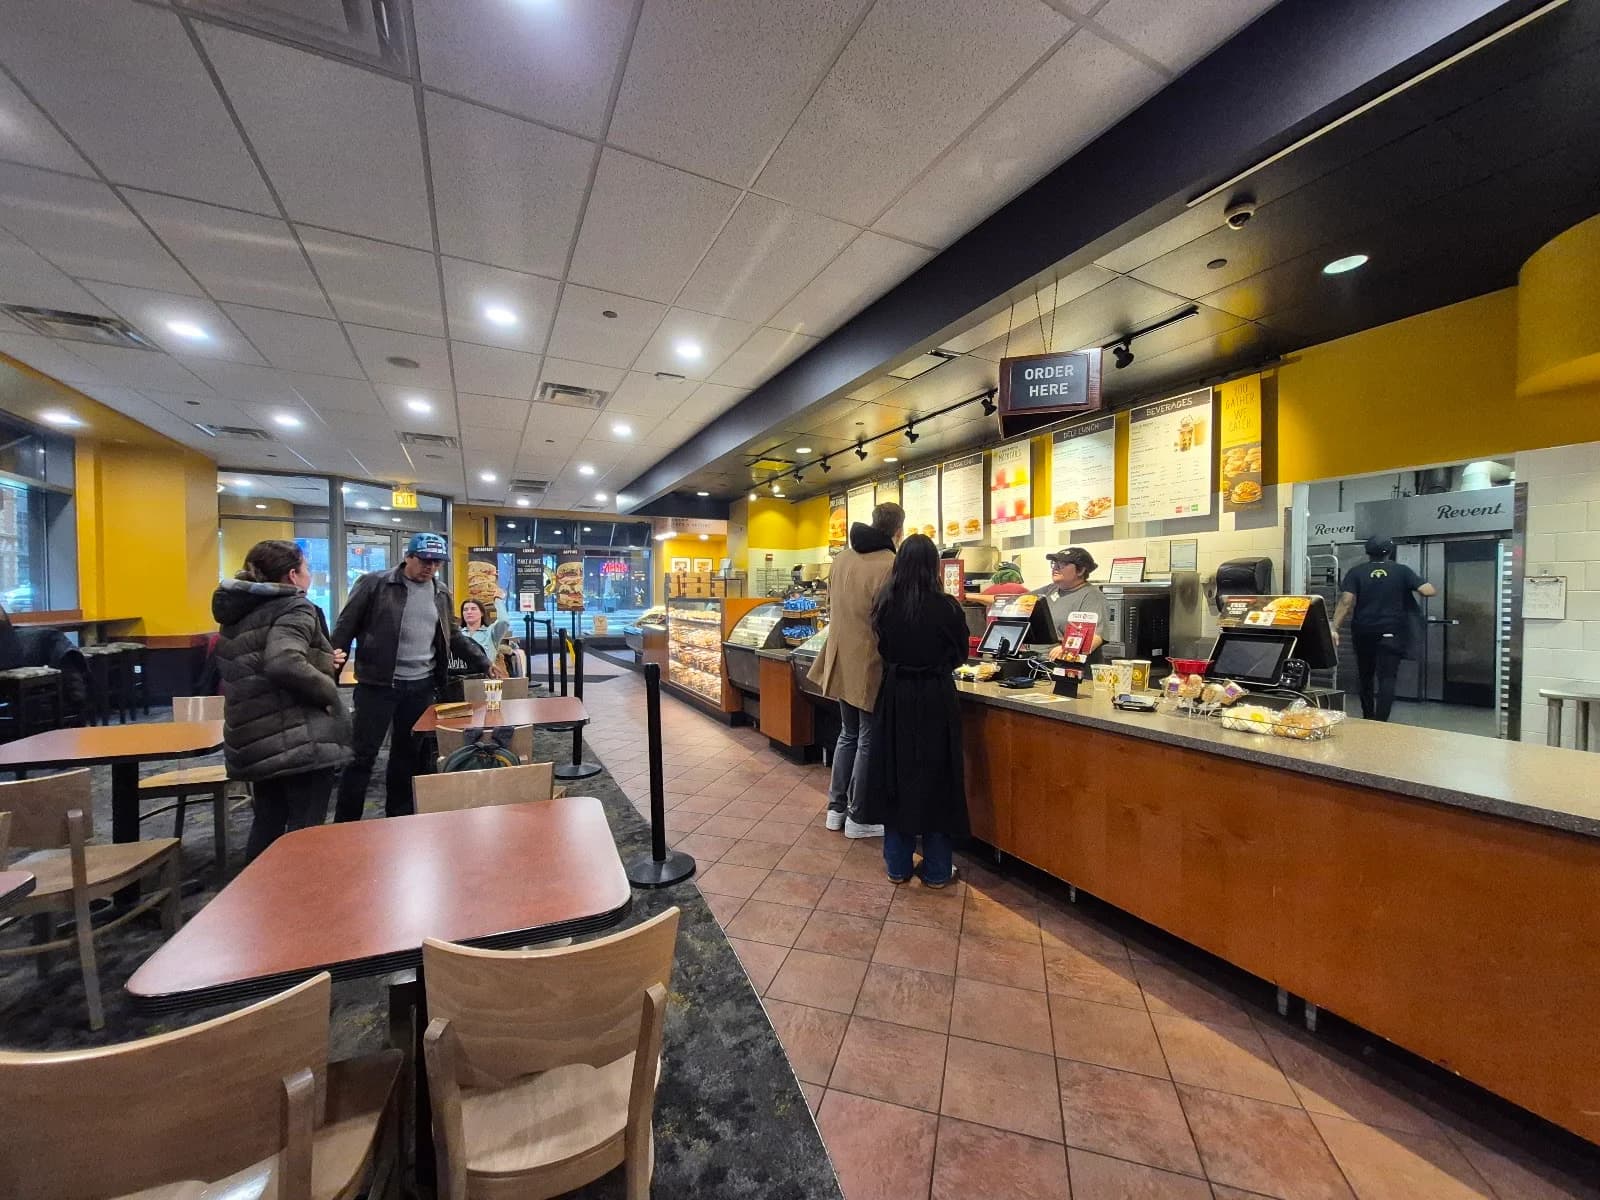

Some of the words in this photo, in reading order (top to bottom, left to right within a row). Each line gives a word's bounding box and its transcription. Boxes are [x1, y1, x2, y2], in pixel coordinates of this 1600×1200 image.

[1024, 364, 1074, 381] ORDER
[1029, 382, 1069, 397] HERE
[1146, 397, 1193, 416] BEVERAGES
[1078, 423, 1100, 435] LUNCH
[395, 494, 414, 505] EXIT
[1437, 502, 1505, 520] Revent
[1314, 523, 1355, 536] Reven
